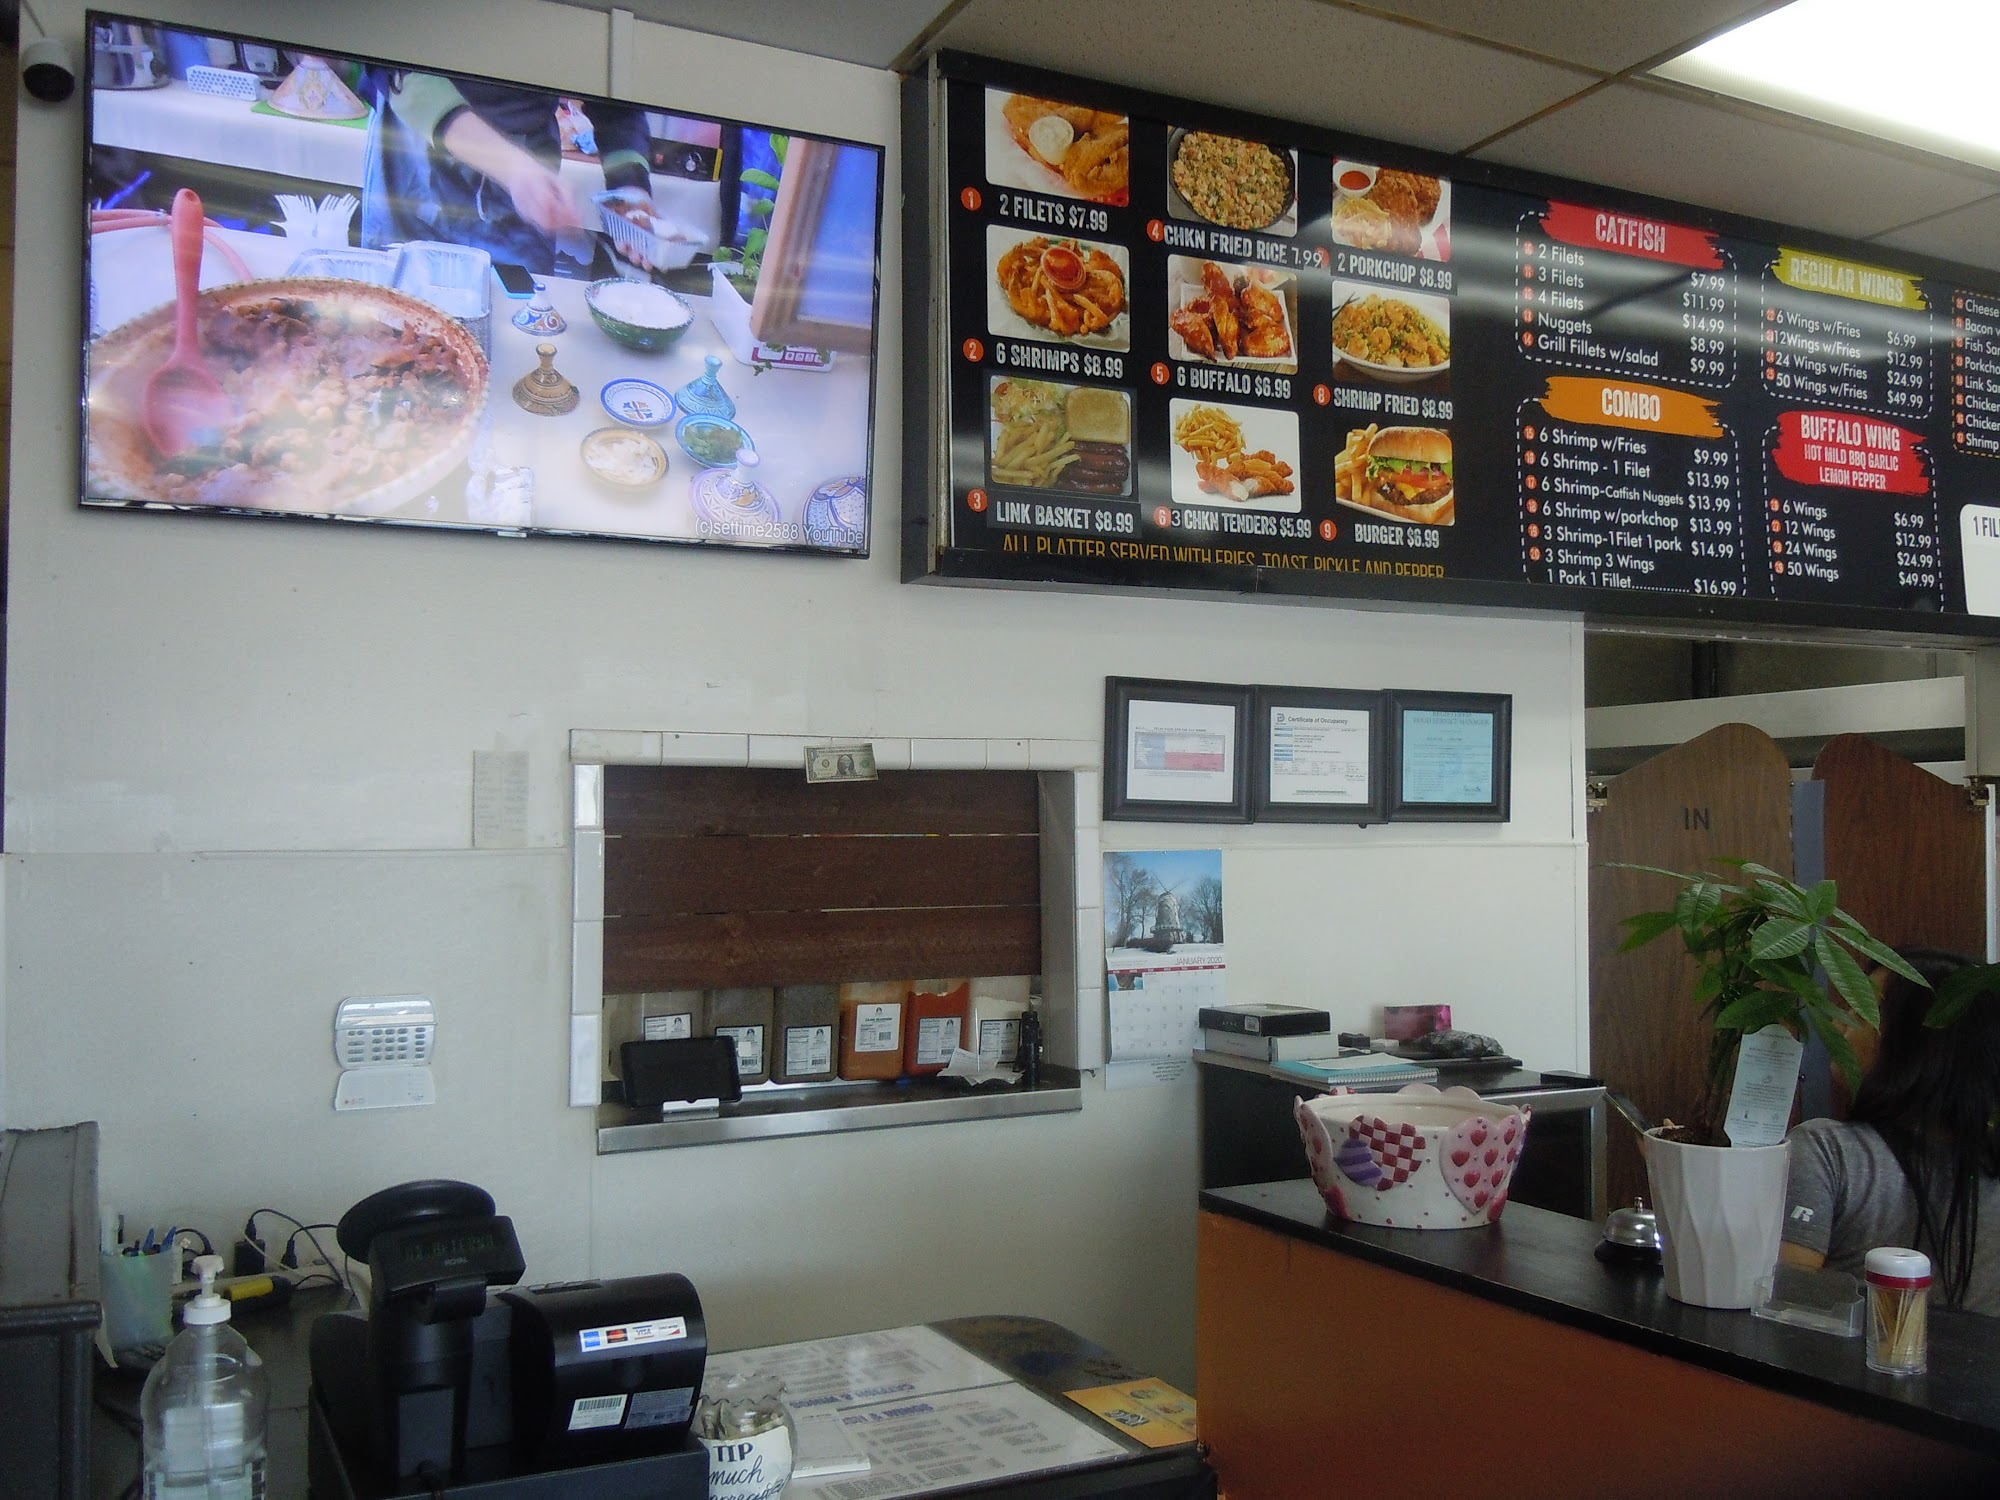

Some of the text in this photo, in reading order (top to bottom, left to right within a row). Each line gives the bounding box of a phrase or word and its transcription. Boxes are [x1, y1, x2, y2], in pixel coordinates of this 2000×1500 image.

[967, 191, 1108, 232] 1 2 FILETS $7.99
[1151, 223, 1160, 239] 4
[1164, 225, 1206, 250] CHKN
[1210, 232, 1253, 258] FRIED
[1256, 240, 1287, 264] RICE
[1291, 247, 1322, 268] 7.99
[1595, 214, 1666, 253] CATFISH
[1337, 253, 1346, 272] 2
[1350, 254, 1417, 284] PORKCHOP
[1420, 266, 1452, 290] $8.99
[1538, 244, 1725, 292] 2 Filets $7.99
[1790, 257, 1905, 302] REGULAR WINGS
[1538, 266, 1725, 313] 3 Filets $11.99
[1538, 289, 1725, 334] 4 Filets $14.99
[1965, 318, 1993, 336] Bacon
[1538, 312, 1725, 355] Nuggets $8.99
[1776, 310, 1917, 349] 6 Wings w/Fries $6.99
[1965, 337, 1983, 353] Fish
[969, 341, 1123, 379] 2 6 SHRIMPS $8.99
[1538, 335, 1725, 377] Grill Fillets w/salad $9.99
[1775, 352, 1923, 389] 24 Wings w/Fries $24.99
[1823, 340, 1861, 358] w/Fries
[1887, 350, 1923, 370] $12.99
[1157, 365, 1291, 400] 5 6 BUFFALO $6.99
[1776, 373, 1923, 408] 50 Wings w/Fries $49.99
[1965, 375, 1984, 390] Link
[1318, 387, 1453, 420] 8 SHRIMP FRIED $8.99
[1601, 387, 1661, 422] COMBO
[1539, 428, 1729, 467] 6 Shrimp w/Fries $9.99
[1801, 414, 1900, 451] BUFFALO WING
[1540, 452, 1730, 490] 6 Shrimp 1 Filet $13.99
[1804, 443, 1899, 472] HOT MILD BBQ GARLIC
[1541, 476, 1550, 492] 6
[1643, 491, 1684, 507] Nuggets
[1688, 495, 1730, 513] $13.99
[1819, 466, 1886, 490] LEMON PEPPER
[973, 492, 1134, 533] 3 LINK BASKET $8.99
[1158, 509, 1312, 539] 6 3 CHKN TENDERS $5.99
[1542, 501, 1732, 536] 6 Shrimp w/porkchop $13.99
[1782, 500, 1924, 528] 6 Wings $6.99
[1973, 516, 2000, 537] 1 FIL
[695, 517, 863, 544] (c)settime2588 YouTube
[1324, 523, 1440, 549] 9 BURGER $6.99
[1544, 526, 1552, 540] 3
[1691, 541, 1734, 559] $14.99
[1784, 520, 1932, 549] 12 Wings $12.99
[1037, 536, 1106, 557] PLATTER
[1110, 542, 1170, 561] SERVED
[1173, 546, 1211, 564] WITH
[1262, 552, 1308, 568] TOAST
[1366, 560, 1392, 575] AND
[1545, 548, 1655, 572] 3 Shrimp 3 Wings
[1785, 541, 1933, 568] 24 Wings $24.99
[1547, 568, 1553, 583] 1
[1559, 570, 1587, 586] Pork
[1591, 572, 1597, 586] 1
[1693, 579, 1737, 596] $16.99
[1787, 562, 1935, 588] 50 Wings $49.99
[1684, 807, 1710, 830] IN
[713, 1442, 753, 1462] TIP
[709, 1455, 764, 1485] much
